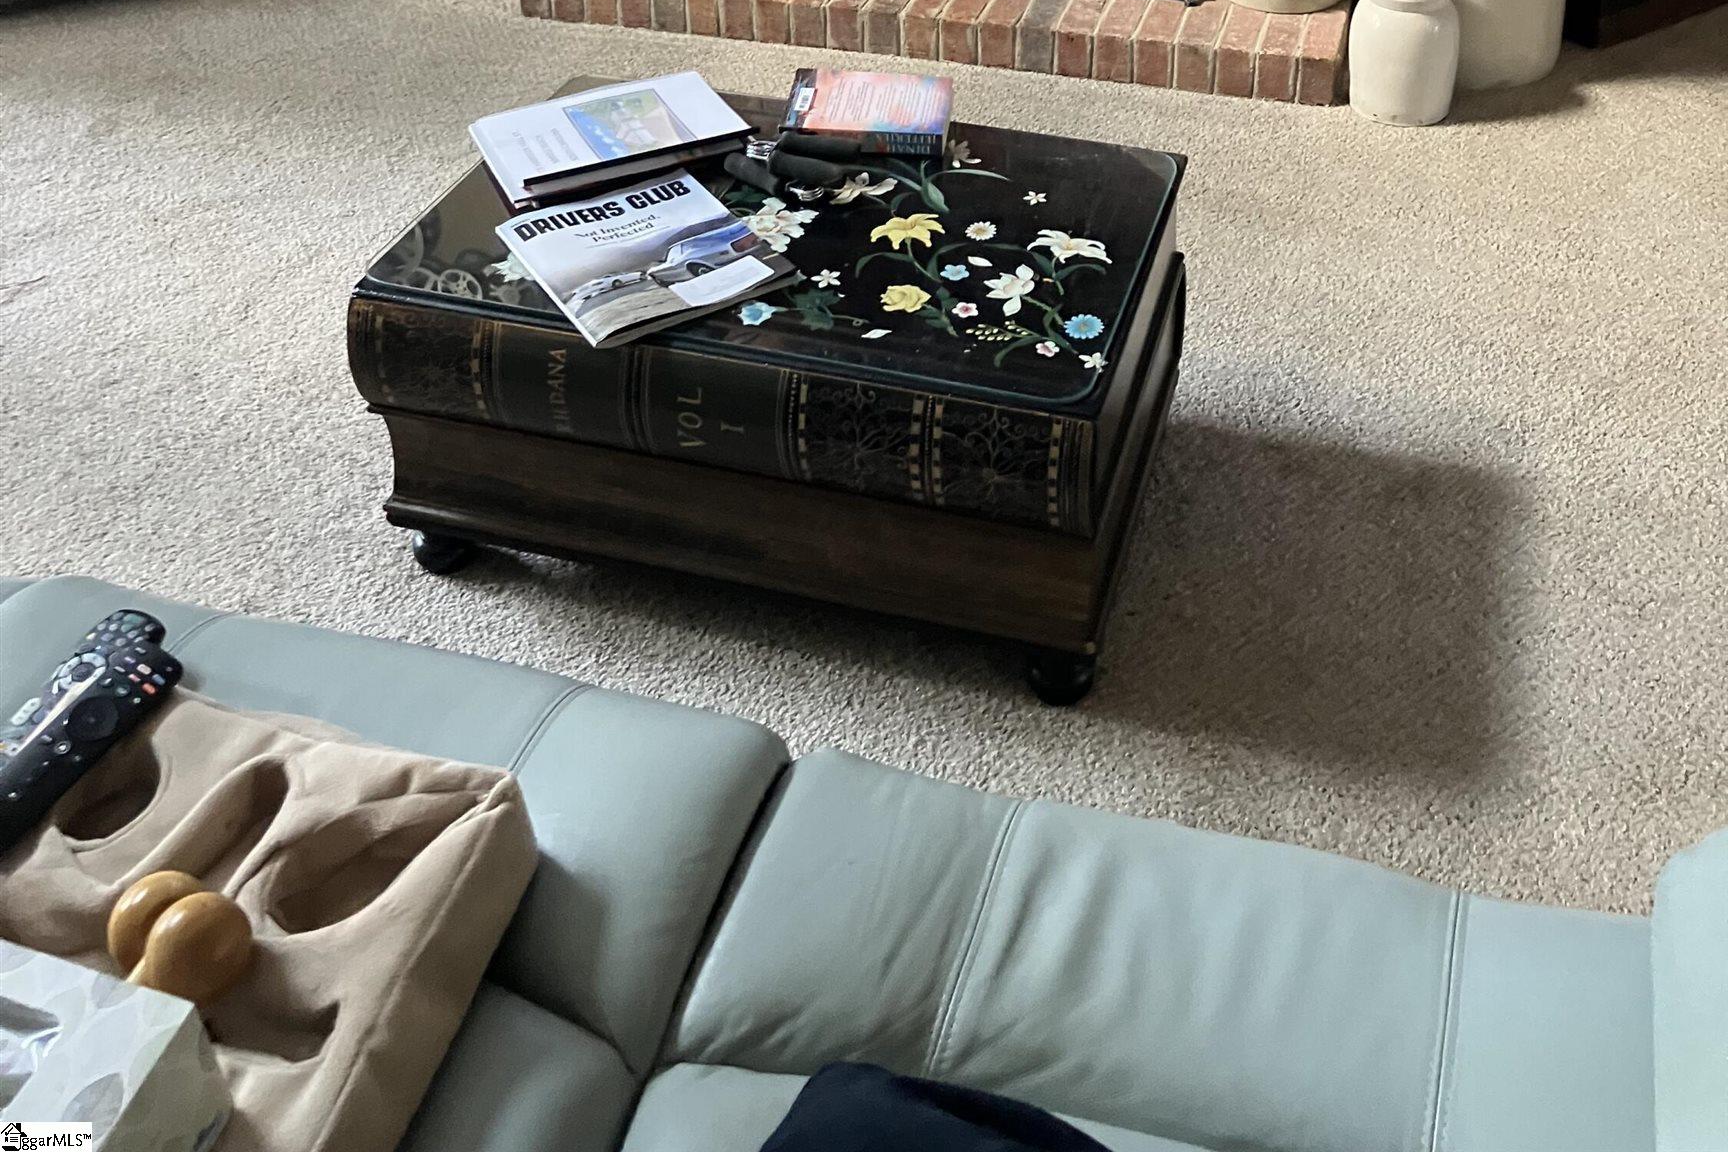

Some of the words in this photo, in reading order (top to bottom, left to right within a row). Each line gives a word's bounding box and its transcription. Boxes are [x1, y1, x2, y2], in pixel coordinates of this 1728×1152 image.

[513, 201, 626, 242] DRIVERS
[625, 180, 691, 210] CLUB
[677, 385, 707, 448] VOL
